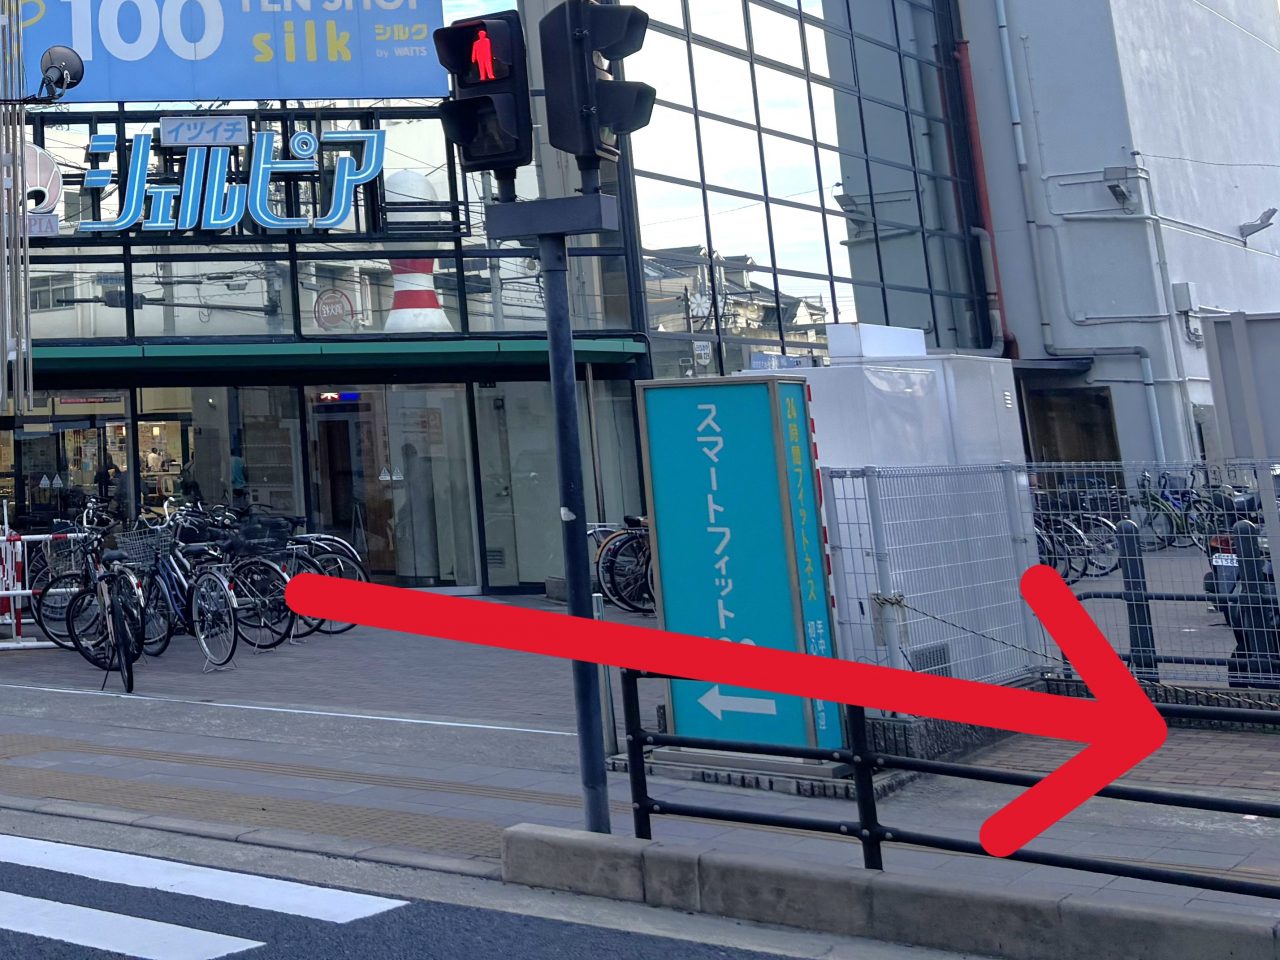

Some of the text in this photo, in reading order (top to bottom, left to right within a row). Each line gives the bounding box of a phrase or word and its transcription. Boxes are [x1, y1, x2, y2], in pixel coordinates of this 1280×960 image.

[253, 20, 428, 62] silk シルク
[394, 45, 428, 57] WATTS
[167, 120, 244, 143] イツイチ
[77, 128, 387, 232] シェルピア
[696, 403, 735, 630] スマートフィット
